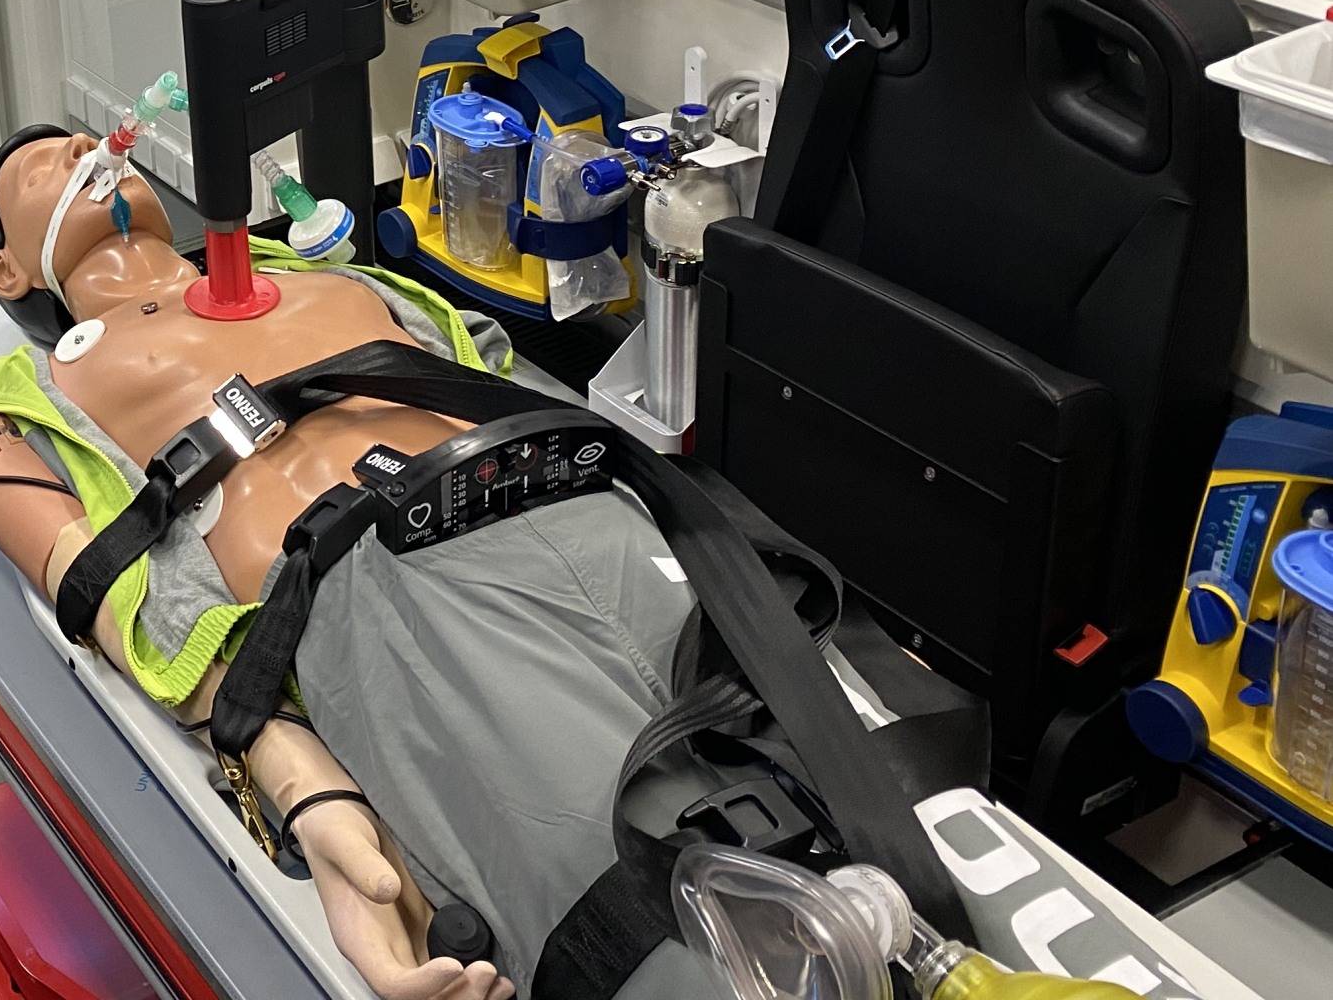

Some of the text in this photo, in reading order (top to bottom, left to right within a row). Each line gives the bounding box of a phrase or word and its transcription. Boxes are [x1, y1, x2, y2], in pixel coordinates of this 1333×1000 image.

[250, 77, 273, 93] corpuls
[225, 387, 266, 428] FERNO
[365, 452, 407, 475] FERNO
[458, 474, 467, 482] 10
[458, 482, 467, 491] 20
[458, 490, 467, 499] 30
[458, 499, 467, 507] 40
[443, 512, 452, 520] 50
[443, 520, 452, 529] 60
[458, 522, 467, 531] 70
[405, 528, 434, 543] Comp.
[424, 535, 437, 544] mm
